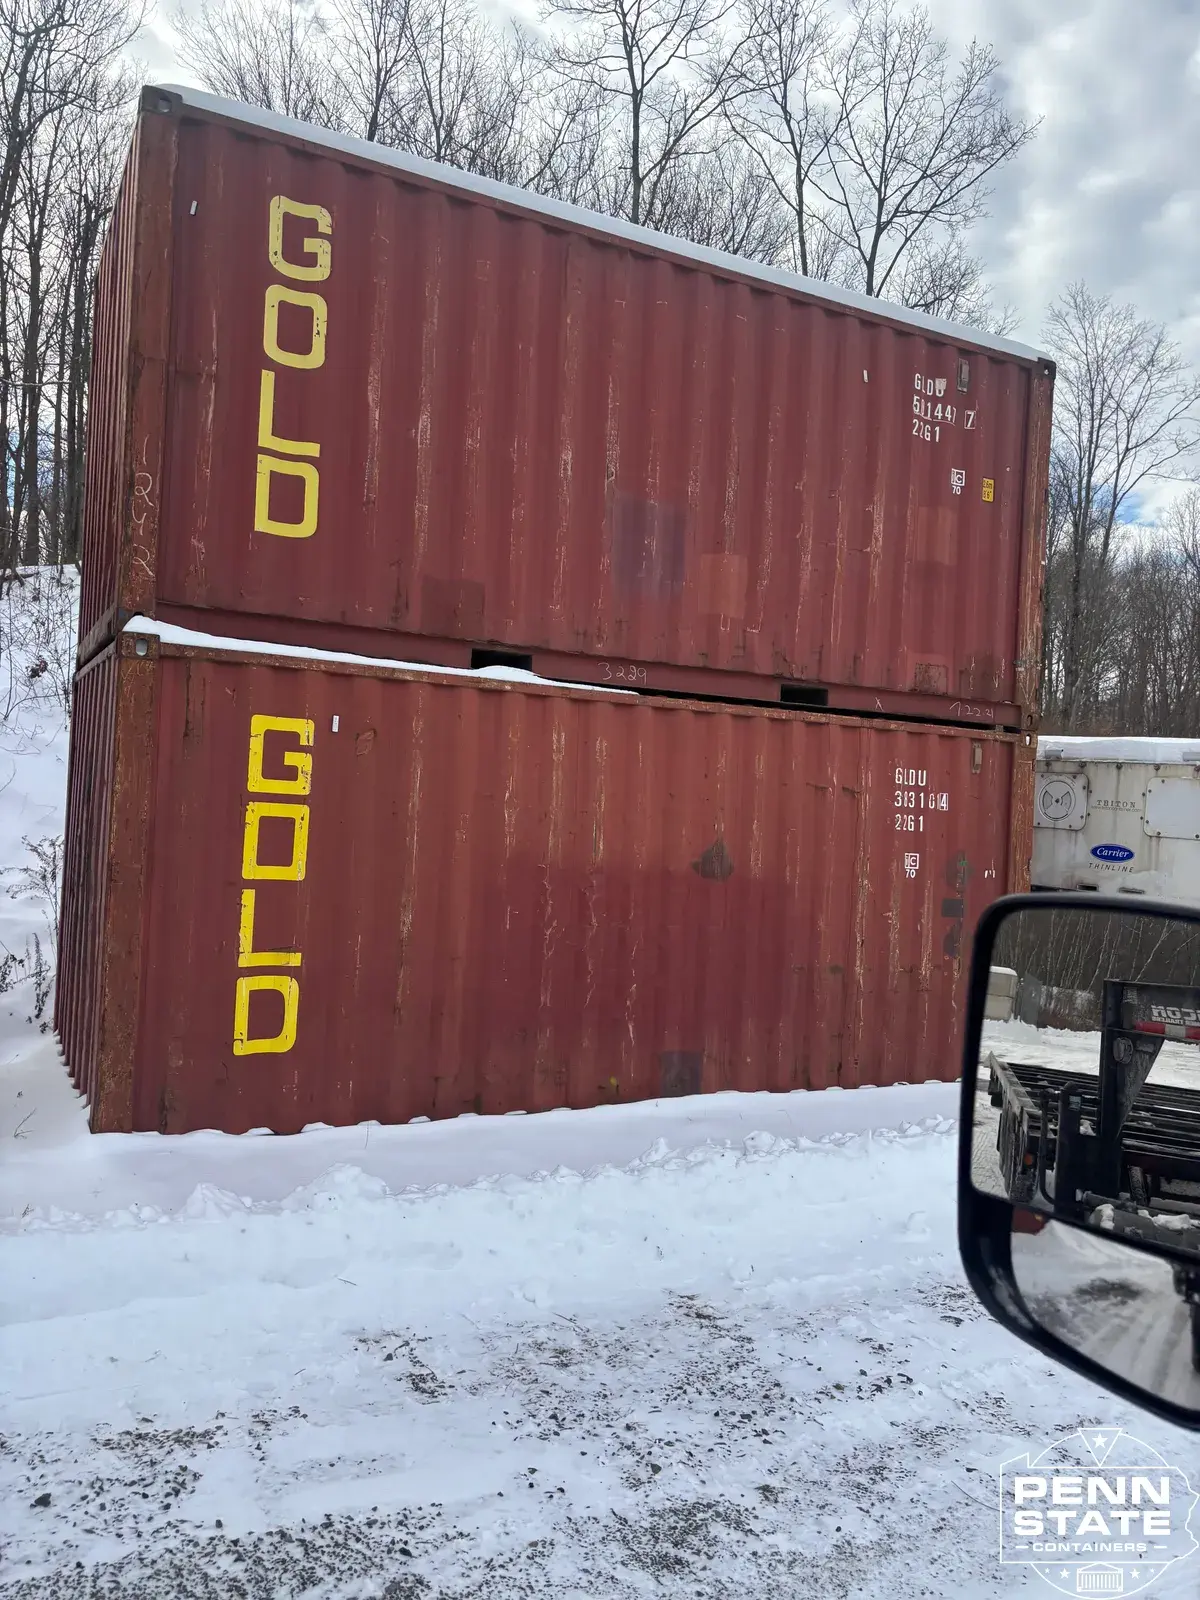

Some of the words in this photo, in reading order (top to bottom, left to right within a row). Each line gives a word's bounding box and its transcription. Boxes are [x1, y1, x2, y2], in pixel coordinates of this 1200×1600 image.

[254, 195, 332, 538] GOLD
[912, 419, 940, 443] 22G1
[952, 486, 961, 495] 70
[895, 768, 926, 786] GLDU
[1096, 800, 1136, 808] TRITON
[895, 814, 923, 831] 22G1
[1096, 847, 1130, 858] Carrier
[906, 869, 916, 878] 70
[1088, 863, 1134, 873] THINLINE
[233, 714, 314, 1056] GOLD
